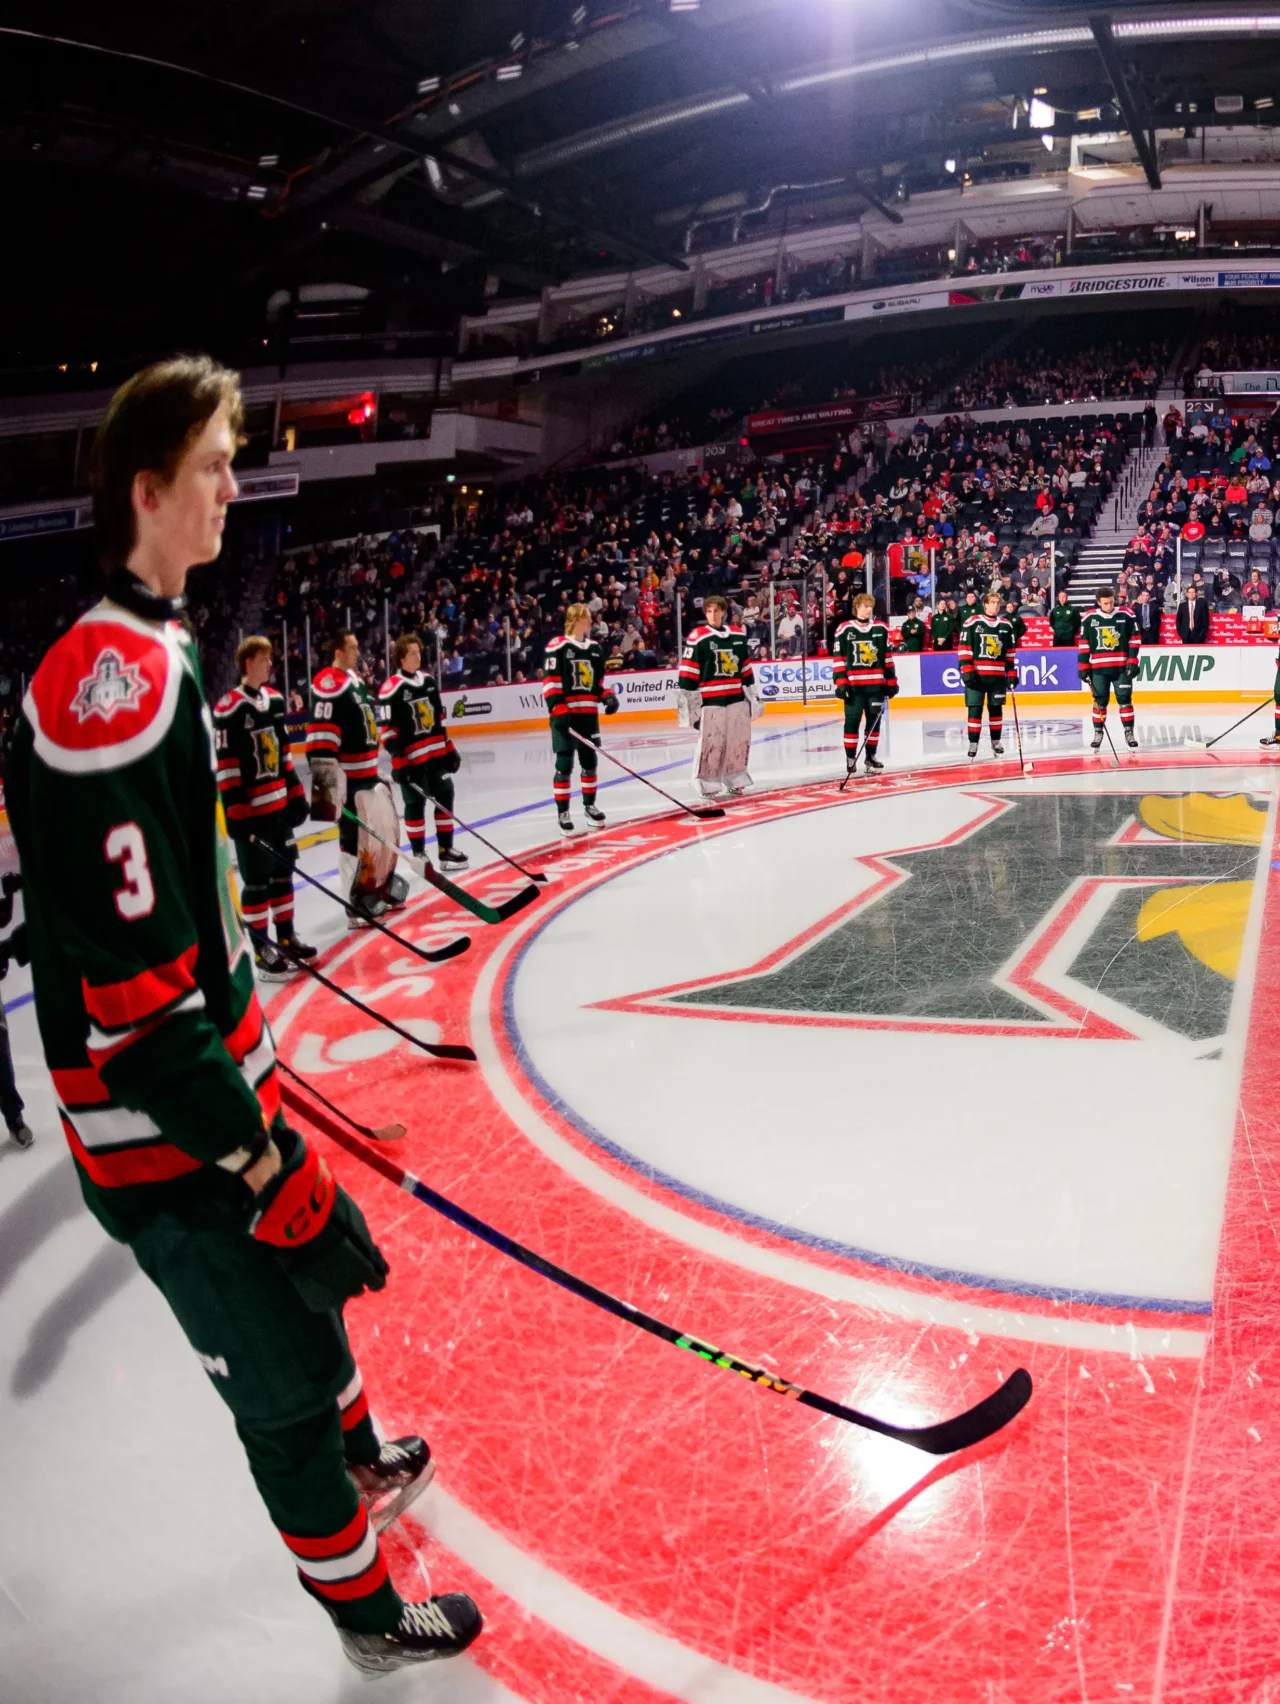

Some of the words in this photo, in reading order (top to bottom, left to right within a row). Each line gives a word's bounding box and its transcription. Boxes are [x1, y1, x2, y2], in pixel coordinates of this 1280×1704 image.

[1068, 276, 1168, 294] BRIDGESTONE
[1182, 275, 1215, 283] Wilsons
[1244, 382, 1261, 391] The
[751, 418, 776, 429] GREAT
[777, 414, 801, 425] TIMES
[801, 412, 818, 421] ARE
[863, 424, 875, 435] 21
[759, 661, 834, 685] Steele
[1138, 654, 1216, 682] MNP
[626, 680, 664, 694] United
[782, 684, 832, 694] SUBARU
[626, 696, 643, 704] Work
[644, 694, 666, 703] United
[314, 701, 333, 719] 60
[104, 820, 156, 923] 3
